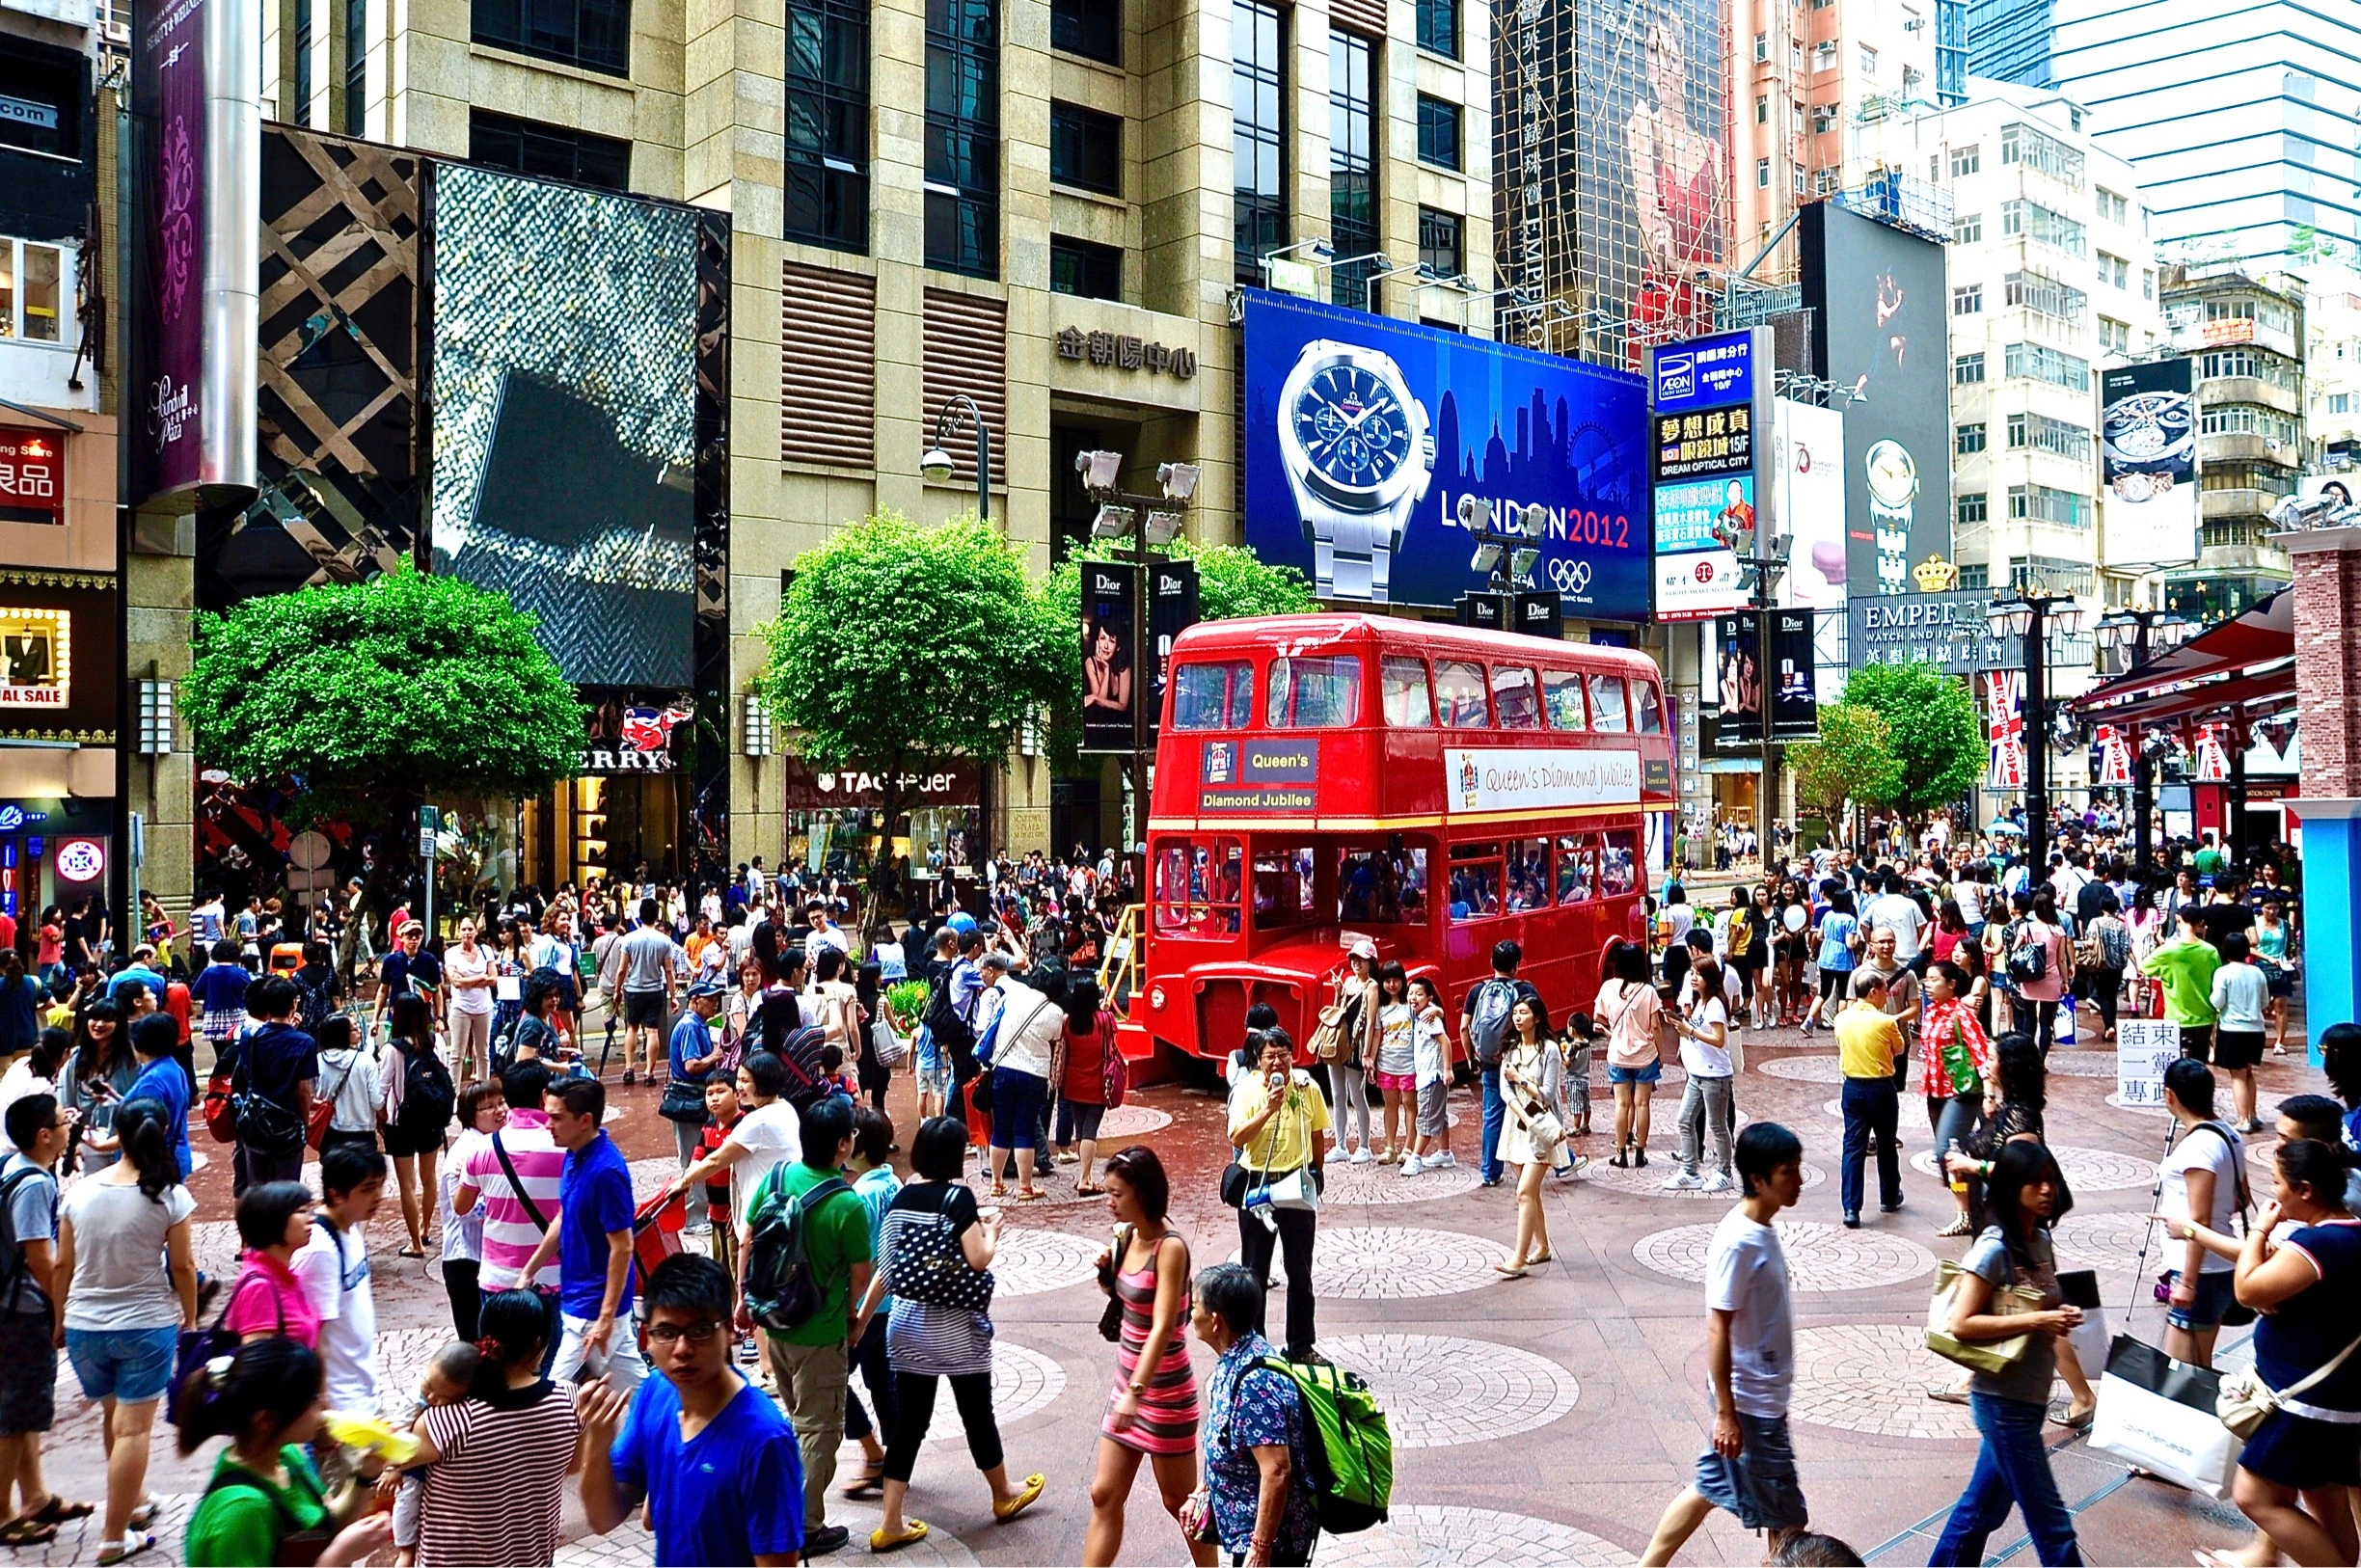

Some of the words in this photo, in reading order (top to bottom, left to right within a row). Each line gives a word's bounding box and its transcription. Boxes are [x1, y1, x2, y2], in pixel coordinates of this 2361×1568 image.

[1057, 324, 1198, 379] 金朝陽中心
[1662, 409, 1749, 444] 夢想成真
[1680, 436, 1728, 461] 眼鏡城
[1729, 435, 1749, 453] 15/F
[1661, 463, 1691, 476] DREAM
[1691, 458, 1728, 473] OPTICAL
[1728, 455, 1750, 468] CITY
[1096, 574, 1121, 590] Dior
[1159, 575, 1182, 591] Dior
[1477, 602, 1495, 616] Dior
[1527, 603, 1550, 617] Dior
[1742, 616, 1755, 629] Dior
[1781, 617, 1804, 629] Dior
[1865, 632, 1905, 642] WATCH
[1911, 630, 1935, 640] AND
[24, 689, 61, 703] SALE
[1252, 753, 1309, 769] Queen's
[1485, 766, 1539, 792] Queen's
[1540, 761, 1597, 789] Diamond
[1595, 761, 1633, 795] Jubilee
[1203, 794, 1260, 807] Diamond
[1262, 794, 1312, 807] Jubilee
[2122, 1023, 2176, 1045] 結束
[2123, 1051, 2176, 1074] 一黨
